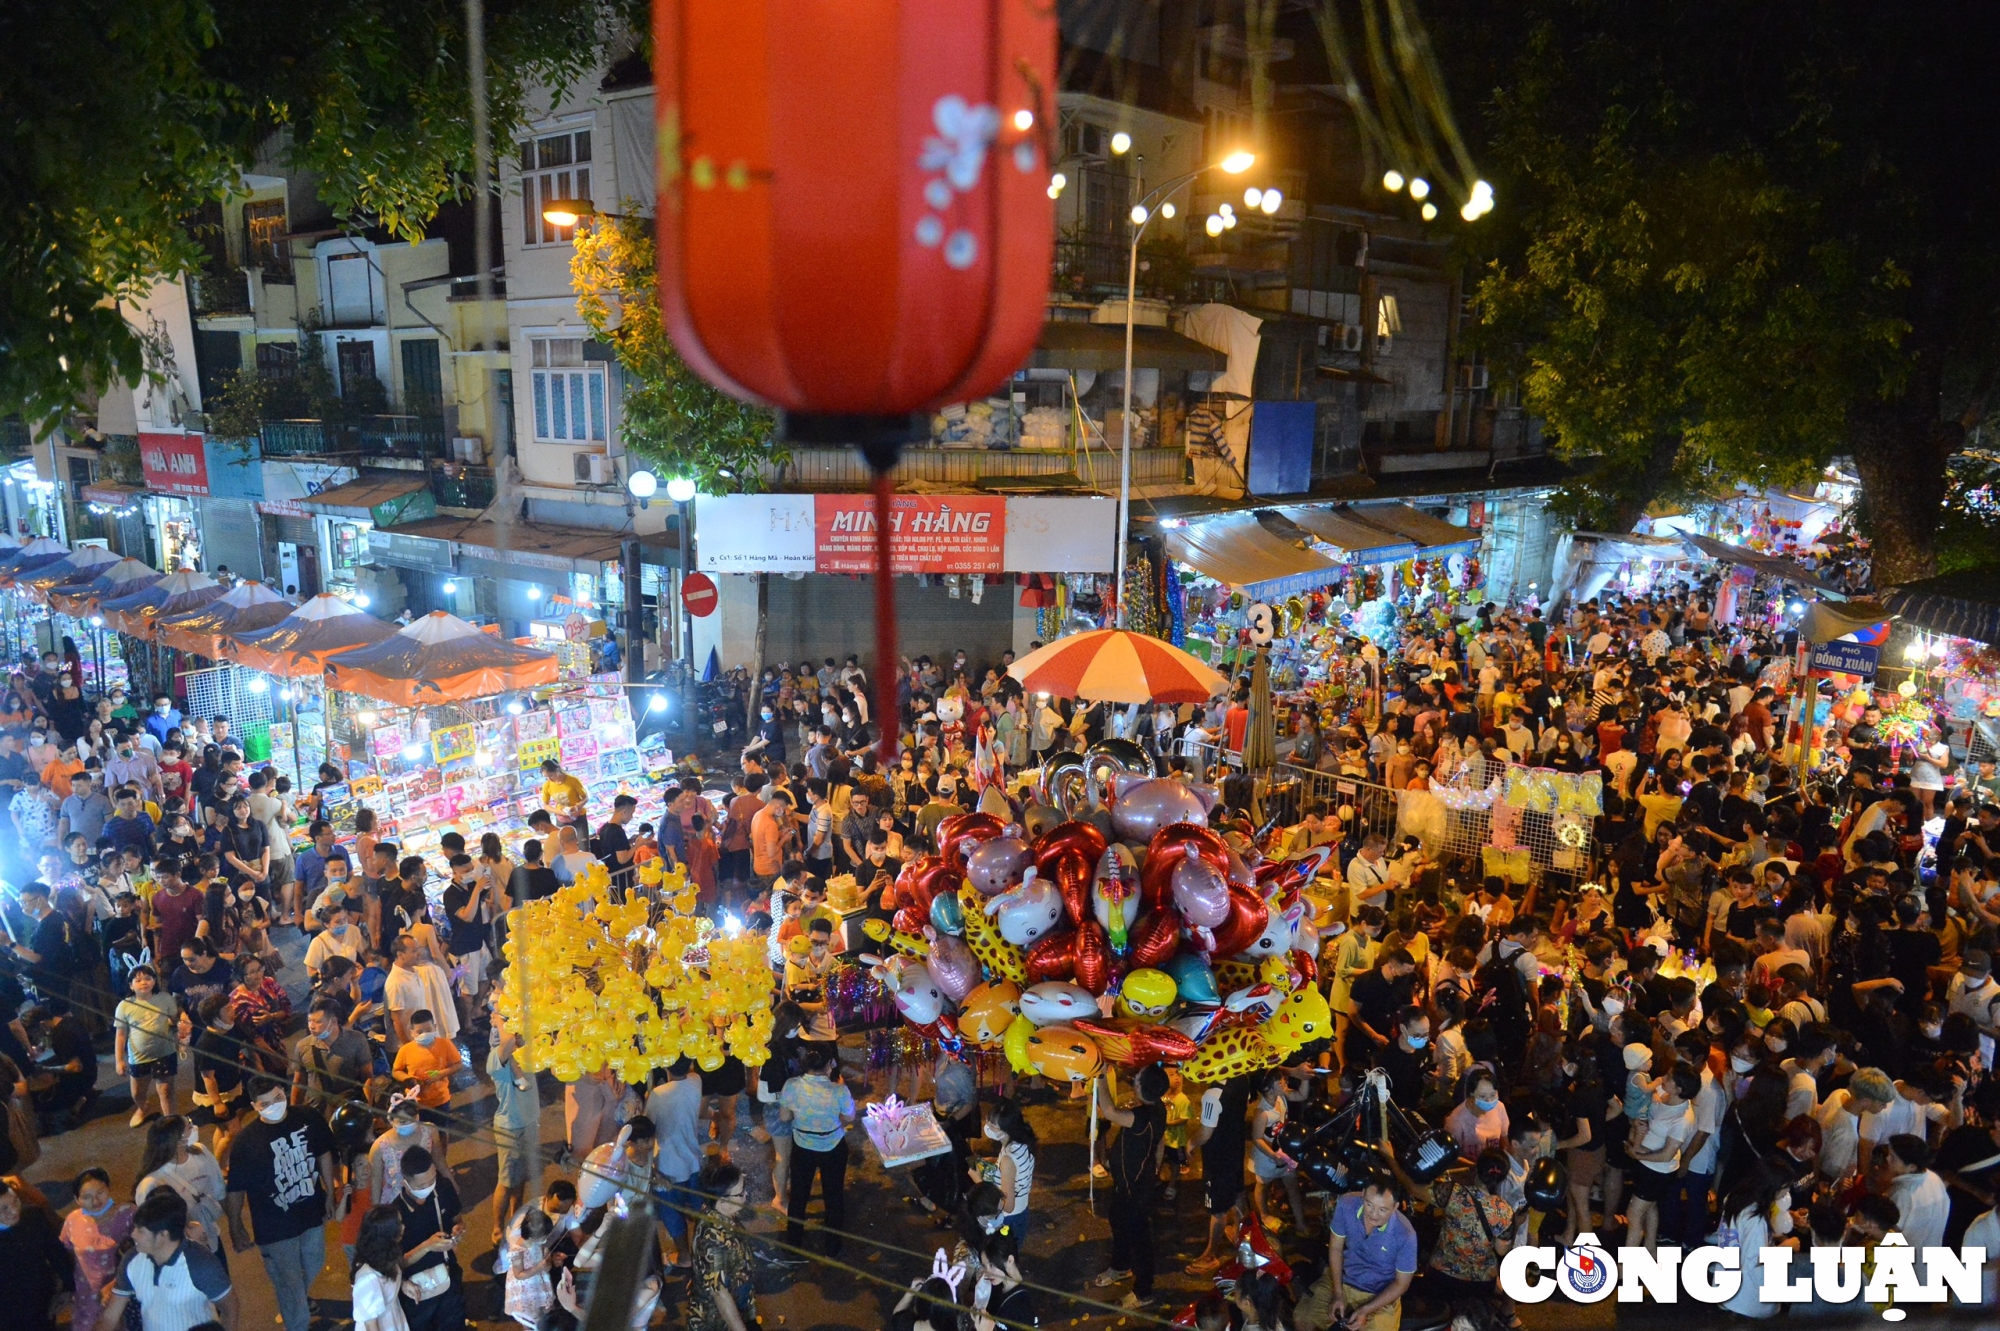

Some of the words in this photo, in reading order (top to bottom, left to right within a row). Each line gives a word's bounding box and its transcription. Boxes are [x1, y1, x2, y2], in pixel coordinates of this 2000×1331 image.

[149, 447, 168, 472] HÀ
[171, 453, 197, 474] ANH
[911, 503, 991, 533] HẰNG
[834, 561, 840, 569] 1
[566, 617, 587, 638] 25K
[1248, 603, 1274, 644] 3
[1841, 646, 1860, 655] PHỐ
[1844, 657, 1873, 673] XUÂN
